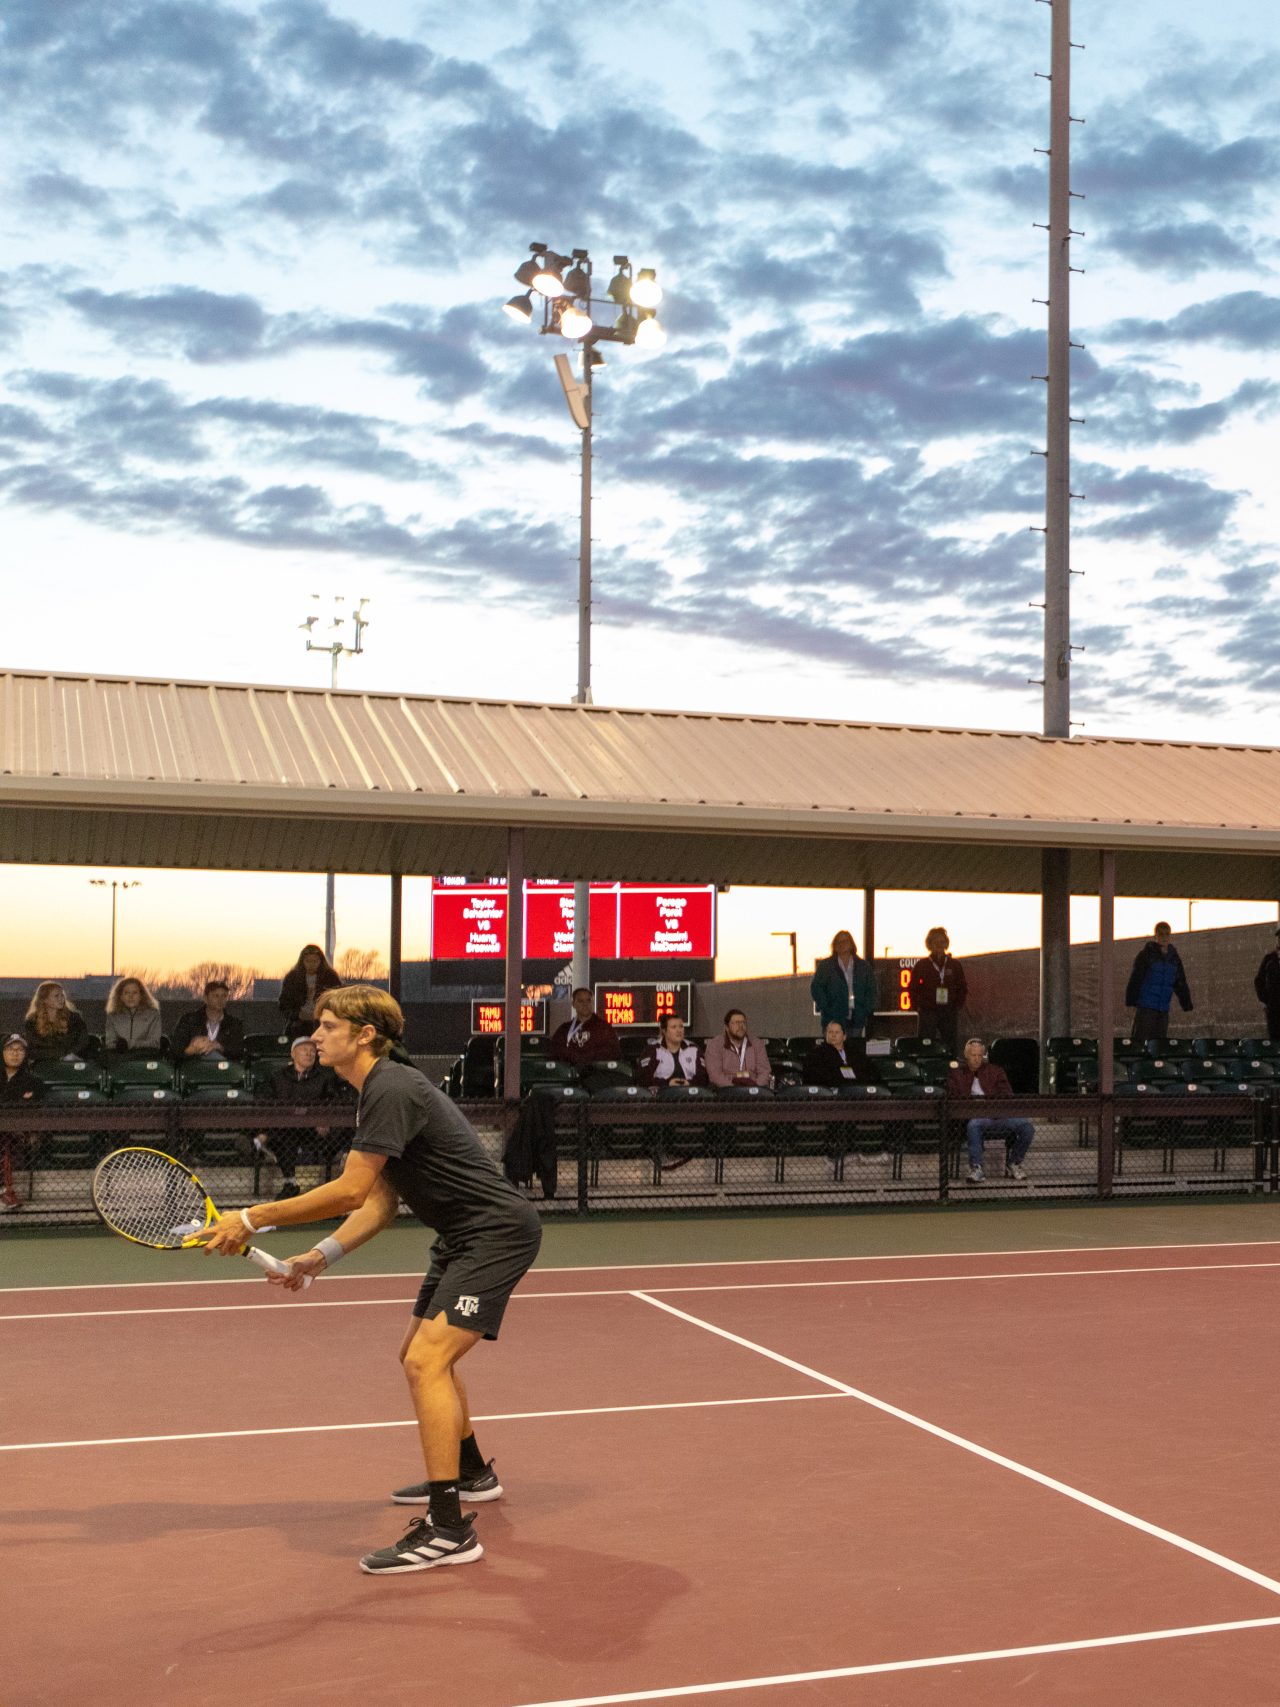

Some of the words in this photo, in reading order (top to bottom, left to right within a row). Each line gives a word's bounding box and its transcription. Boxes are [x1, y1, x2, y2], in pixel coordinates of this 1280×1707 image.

[899, 958, 920, 968] COU
[655, 983, 675, 992] COURT
[605, 992, 632, 1008] TAMU
[480, 1006, 501, 1019] TAMU
[605, 1008, 634, 1024] TEXAS
